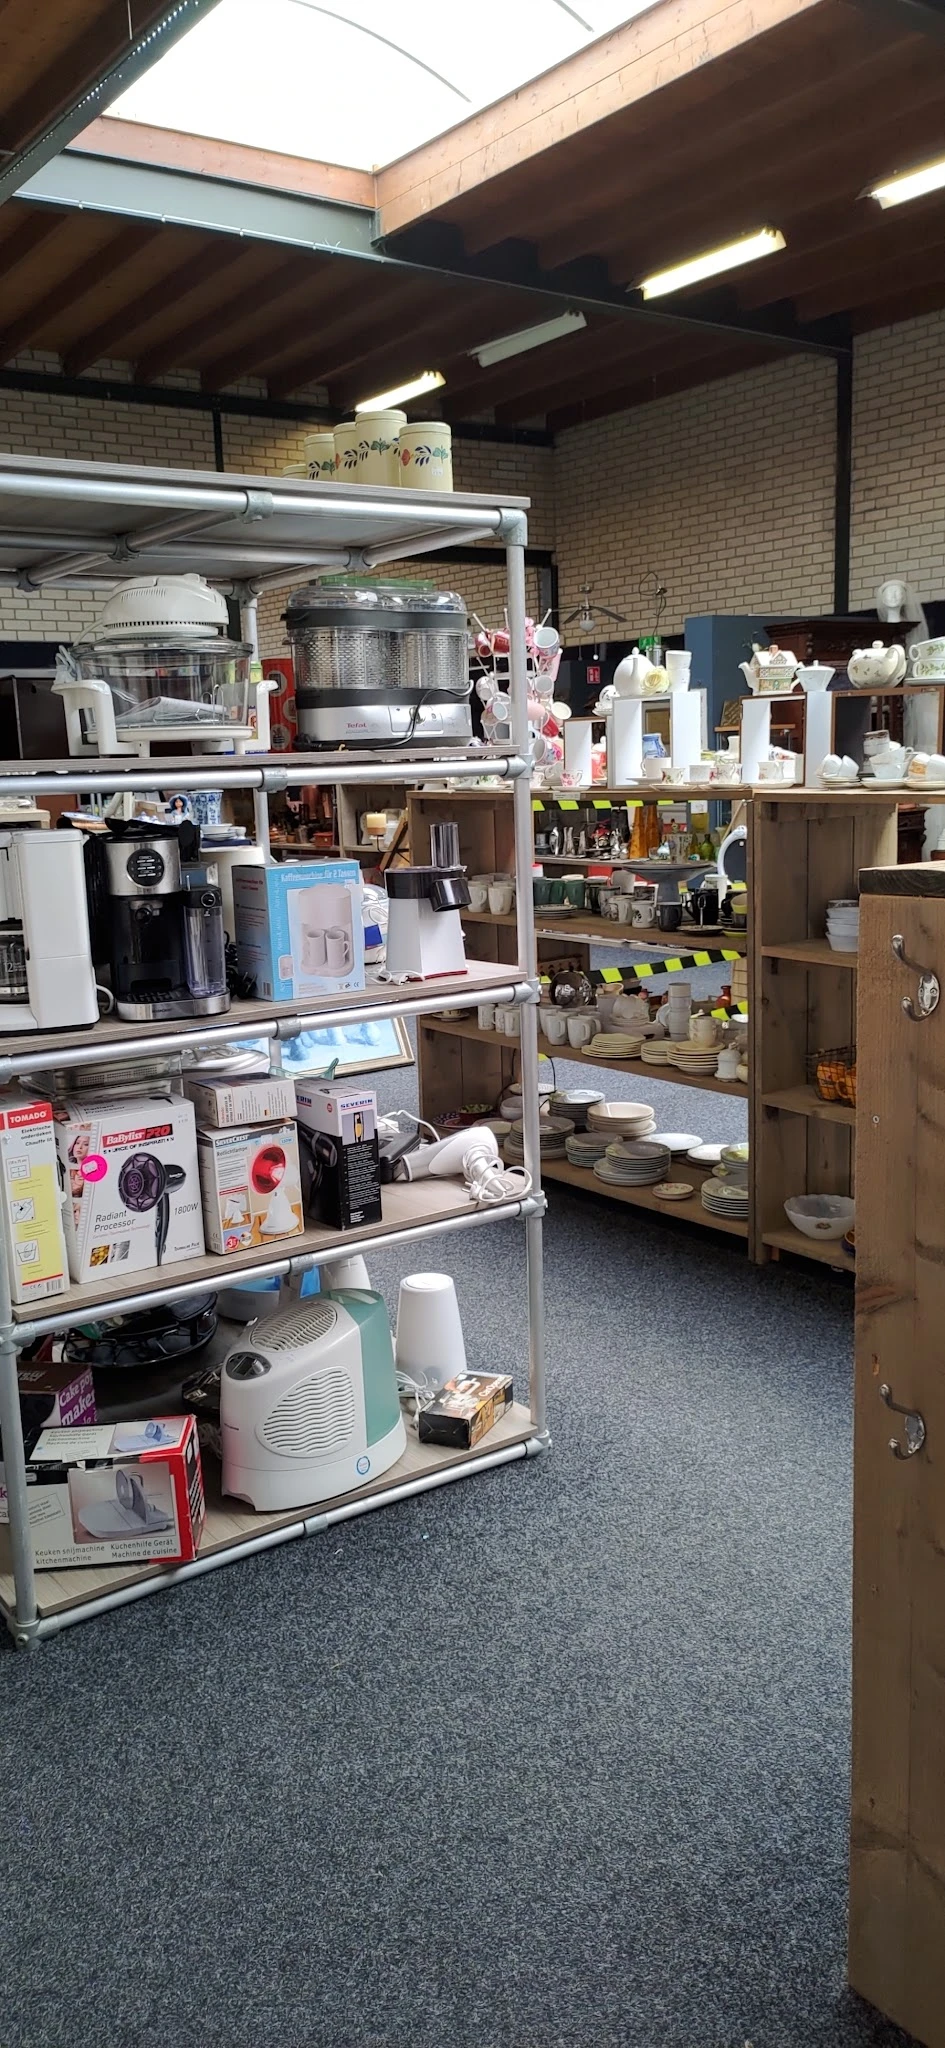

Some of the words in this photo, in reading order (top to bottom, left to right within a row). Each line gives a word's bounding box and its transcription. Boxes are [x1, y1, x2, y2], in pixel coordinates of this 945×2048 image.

[3, 962, 14, 972] 12
[340, 1099, 373, 1108] SEVERIN
[10, 1111, 47, 1124] TOMADO
[106, 1130, 146, 1145] BaByliss
[146, 1125, 171, 1138] PRO
[174, 1202, 199, 1216] 1800W
[95, 1210, 127, 1223] Radiant
[94, 1219, 137, 1233] Processor
[60, 1384, 80, 1407] Cake
[34, 1549, 61, 1557] Keuken
[62, 1545, 105, 1555] snijmachine
[36, 1555, 92, 1565] kitchenmachine
[111, 1550, 141, 1559] Machine
[152, 1547, 178, 1556] cuisine
